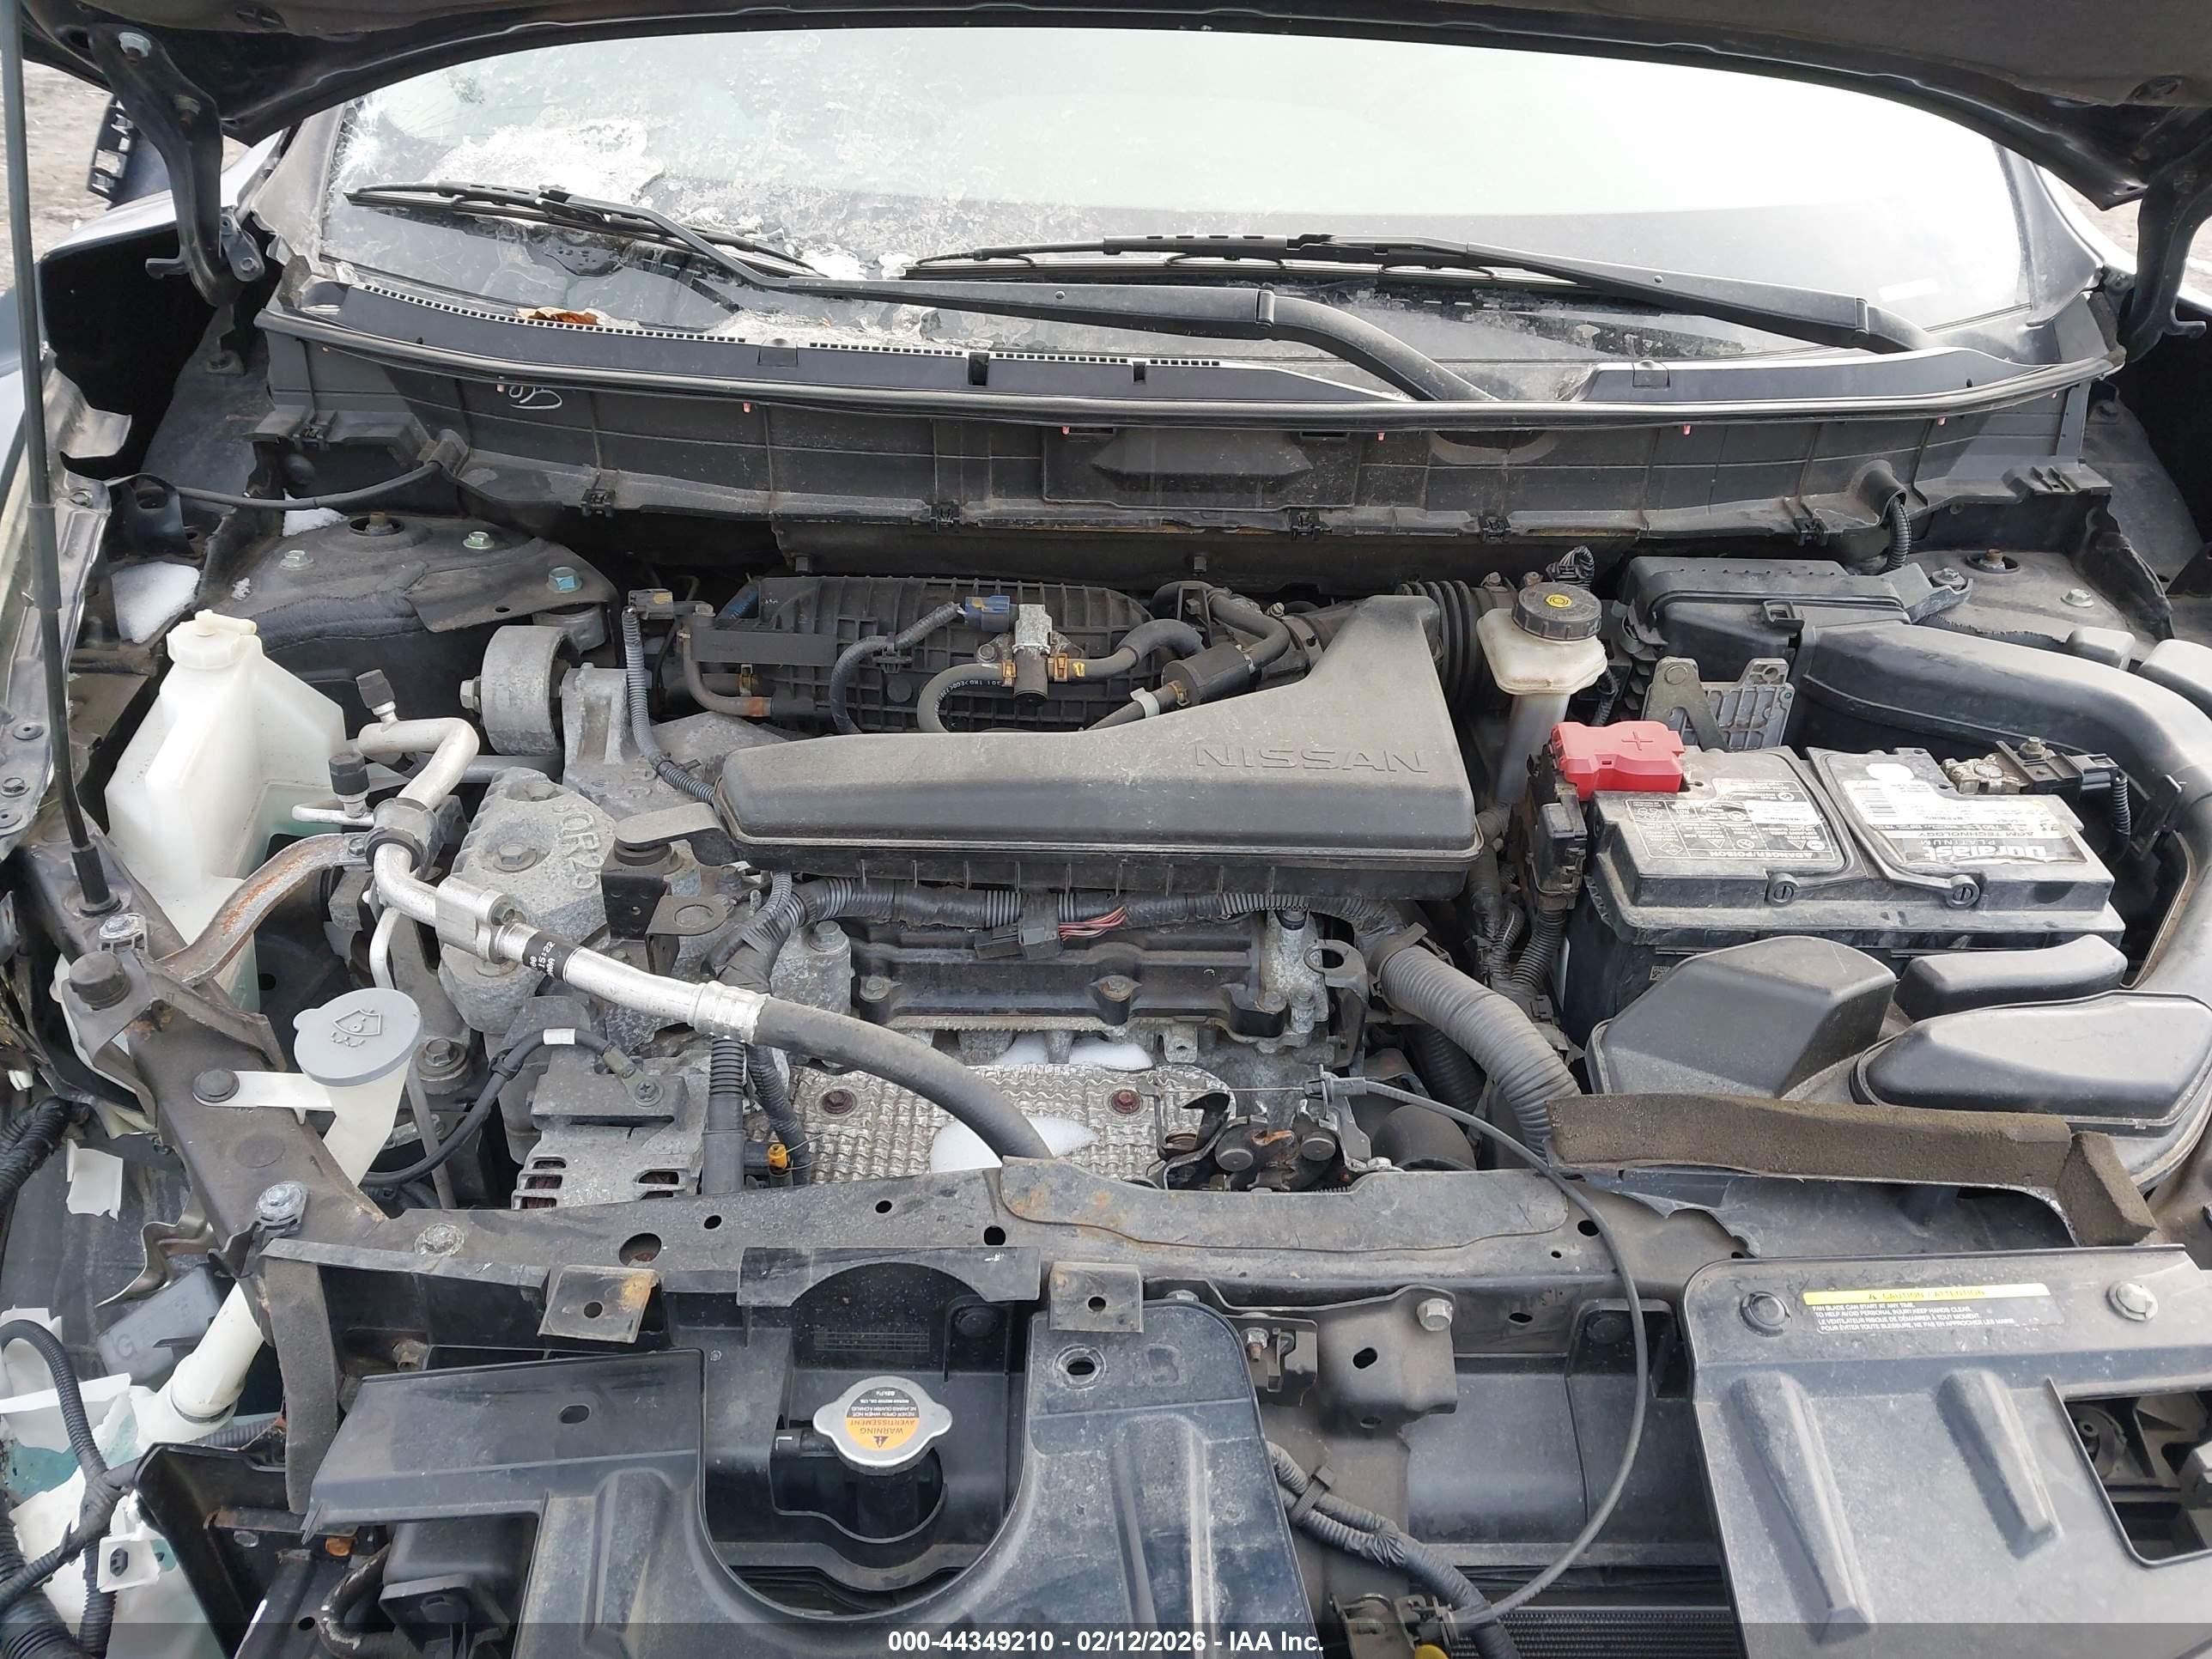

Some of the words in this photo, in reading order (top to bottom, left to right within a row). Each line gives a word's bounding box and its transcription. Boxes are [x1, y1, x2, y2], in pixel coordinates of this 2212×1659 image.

[1195, 745, 1429, 773] NISSAN
[538, 941, 556, 969] 15:22
[1883, 1291, 1923, 1300] CAUTION
